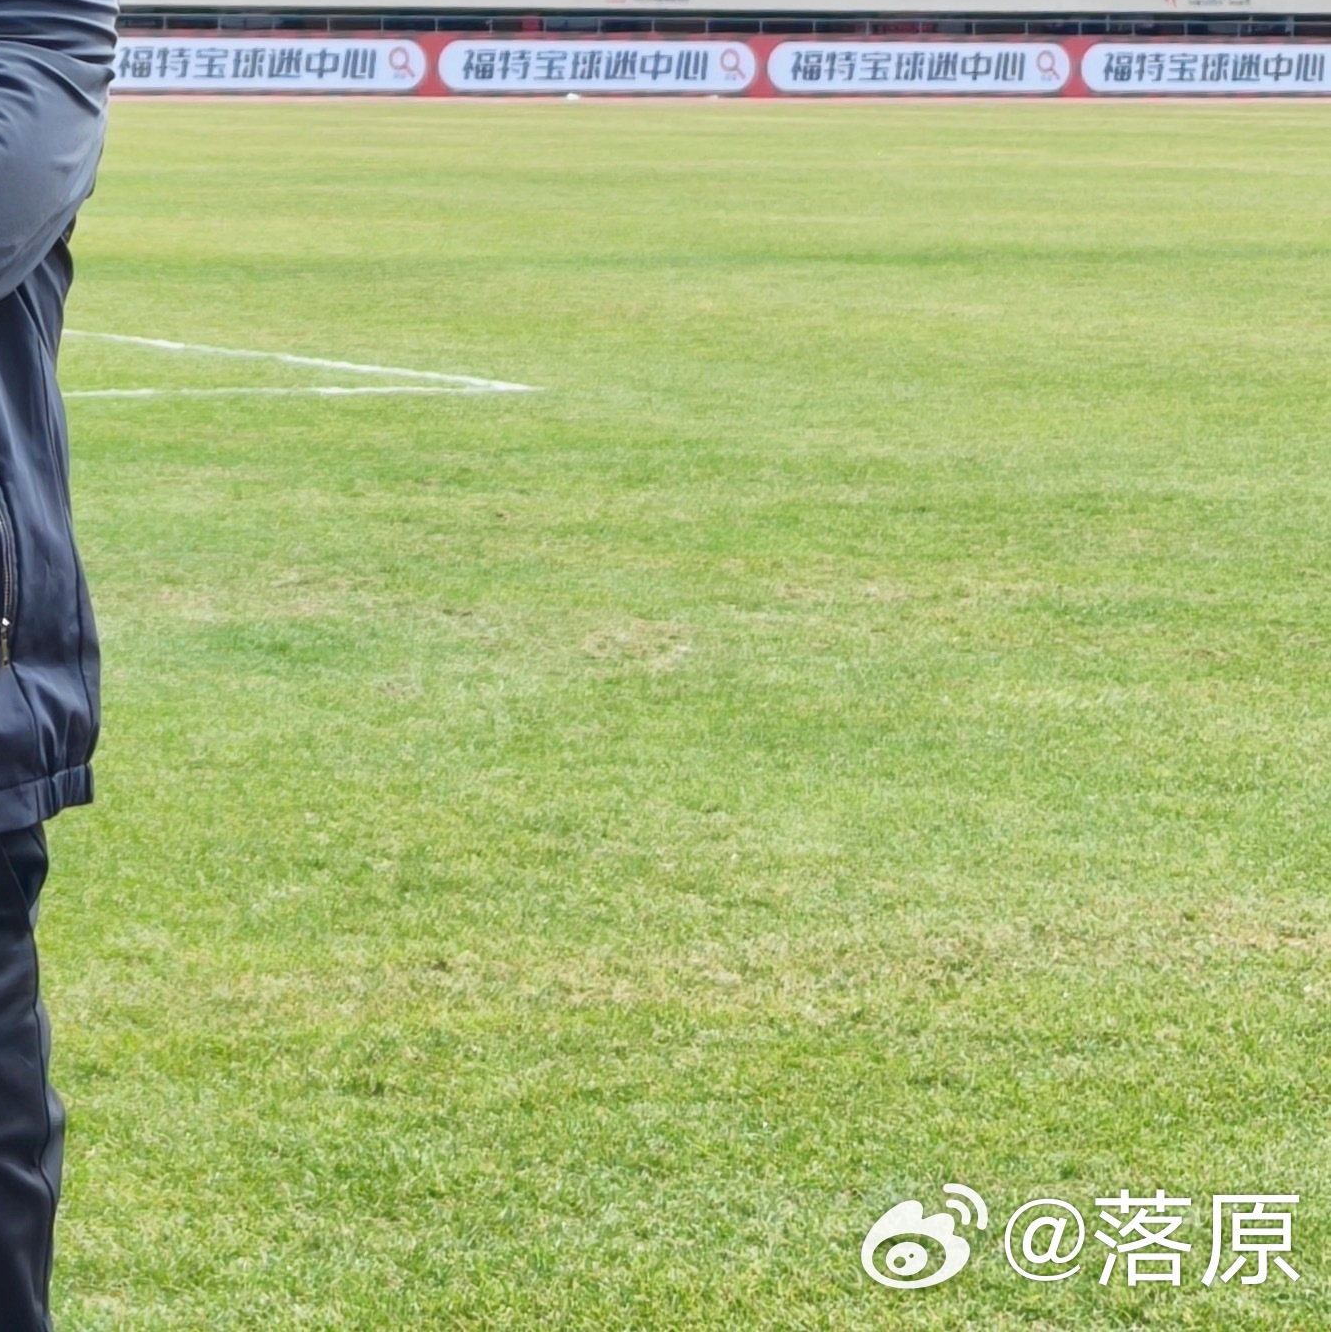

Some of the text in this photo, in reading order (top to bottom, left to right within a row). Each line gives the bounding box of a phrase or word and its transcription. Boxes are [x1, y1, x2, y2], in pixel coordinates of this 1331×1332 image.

[118, 47, 377, 79] 福特宝球迷中心
[462, 49, 709, 80] 福特宝球迷中心
[790, 52, 1026, 81] 福特宝球迷中心
[1102, 52, 1325, 81] 福特宝球迷中心
